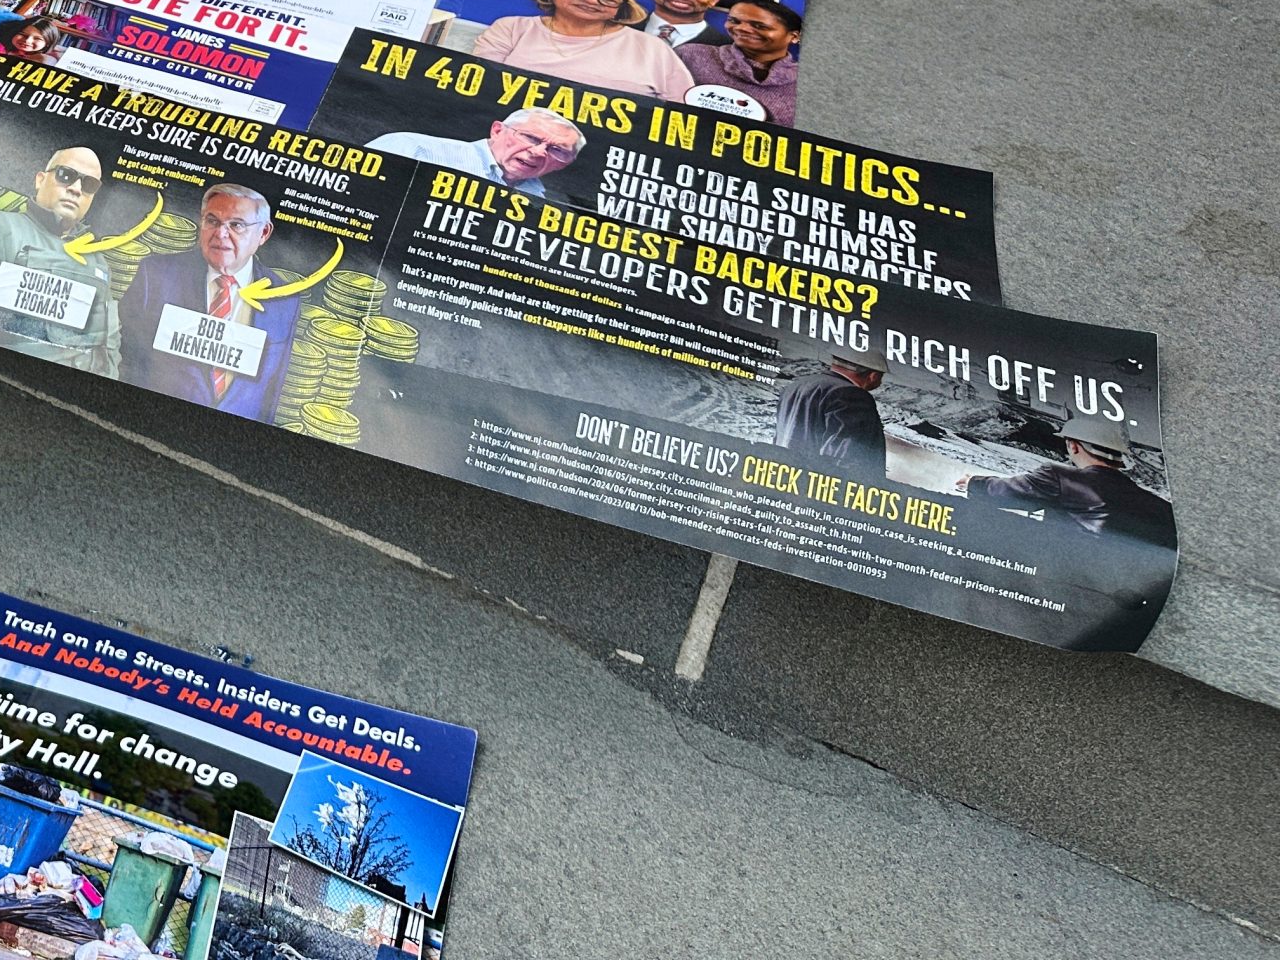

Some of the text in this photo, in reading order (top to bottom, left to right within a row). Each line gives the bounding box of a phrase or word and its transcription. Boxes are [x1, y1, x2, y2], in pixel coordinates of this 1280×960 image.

[171, 27, 225, 49] JAMES
[193, 6, 262, 38] FOR
[268, 27, 308, 52] IT.
[379, 11, 407, 22] PAID
[116, 25, 266, 80] SOLOMON
[7, 62, 81, 94] HAVE
[80, 82, 106, 102] A
[112, 84, 263, 143] TROUBLING
[268, 128, 387, 181] RECORD.
[28, 92, 82, 120] O'DEA
[85, 103, 144, 134] KEEPS
[147, 122, 200, 151] SURE
[199, 138, 221, 156] IS
[223, 143, 352, 195] CONCERNING.
[360, 39, 967, 219] IN 40 YEARS IN POLITICS...
[429, 170, 879, 320] BILL'S BIGGEST BACKERS?
[14, 289, 68, 320] THOMAS
[19, 271, 73, 300] SUDHAN
[483, 264, 522, 282] hundreds
[535, 279, 580, 298] thousands
[581, 292, 591, 300] of
[592, 294, 623, 309] dollars
[197, 317, 225, 341] BOB
[422, 200, 1138, 426] THE DEVELOPERS GETTING RICH OFF US.
[170, 332, 242, 369] MENENDEZ
[470, 432, 477, 440] 2:
[466, 456, 472, 465] 4:
[576, 412, 957, 536] DON'T BELIEVE US? CHECK THE FACTS HERE:
[4, 610, 421, 752] Trash on the Streets. Insiders Get Deals.
[27, 739, 102, 779] Hall.
[61, 712, 115, 744] for
[119, 732, 238, 789] change
